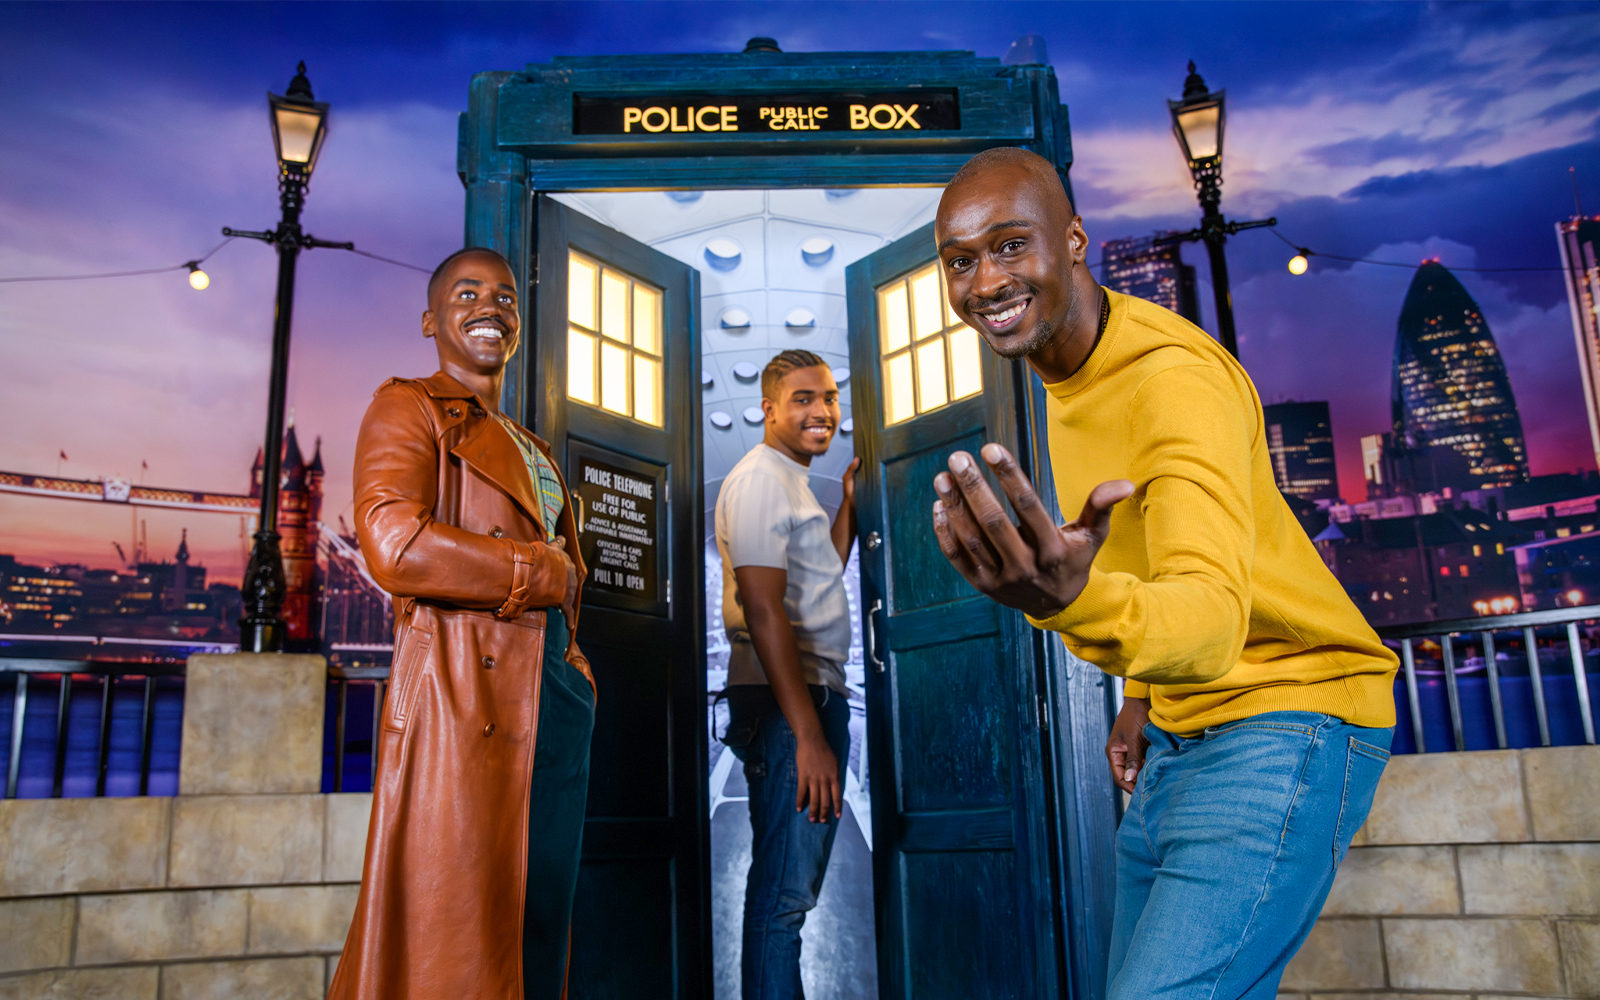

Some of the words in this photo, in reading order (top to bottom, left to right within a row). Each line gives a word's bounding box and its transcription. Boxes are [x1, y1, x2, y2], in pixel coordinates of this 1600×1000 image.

[623, 105, 739, 133] POLICE
[759, 106, 829, 120] PUBLIC
[849, 104, 921, 131] BOX
[769, 117, 821, 131] CALL
[584, 465, 612, 489] POLICE
[613, 473, 653, 500] TELEPHONE
[602, 492, 620, 506] FREE
[621, 497, 636, 511] FOR
[592, 501, 607, 514] USE
[608, 505, 619, 517] OF
[620, 508, 646, 524] PUBLIC
[584, 522, 618, 538] OBTAINABLE
[590, 516, 611, 527] ADVICE
[611, 521, 616, 529] &
[617, 522, 648, 537] ASSISTANCE
[596, 539, 622, 552] OFFICERS
[628, 546, 642, 557] CARS
[602, 548, 628, 560] RESPOND
[629, 554, 637, 563] TO
[600, 555, 622, 567] URGENT
[623, 560, 639, 571] CALLS
[594, 567, 612, 585] PULL
[614, 571, 623, 587] TO
[626, 574, 645, 591] OPEN
